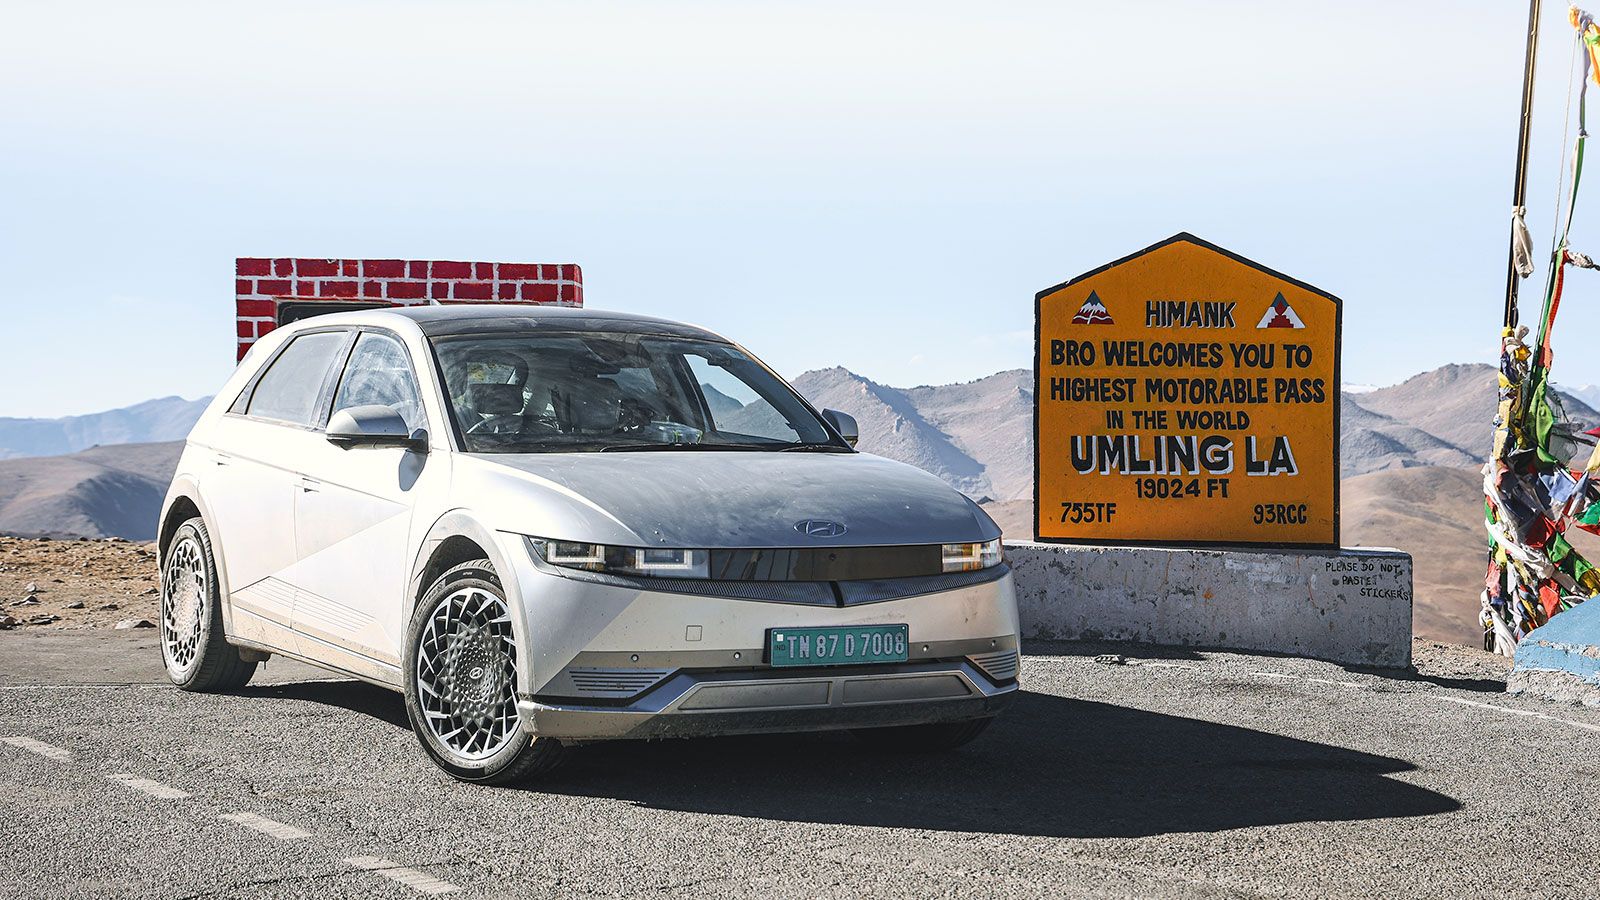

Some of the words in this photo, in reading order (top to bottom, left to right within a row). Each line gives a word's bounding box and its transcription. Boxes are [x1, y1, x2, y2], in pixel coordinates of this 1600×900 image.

[1145, 300, 1237, 328] HIMANK
[1050, 339, 1096, 367] BRO
[1103, 340, 1224, 368] WELCOMES
[1230, 343, 1274, 369] YOU
[1283, 344, 1313, 368] TO
[1050, 377, 1137, 403] HIGHEST
[1145, 378, 1268, 404] MOTORABLE
[1274, 378, 1325, 404] PASS
[1106, 410, 1124, 430] IN
[1131, 410, 1168, 430] THE
[1176, 410, 1250, 430] WORLD
[1070, 435, 1234, 476] UMLING
[1245, 435, 1299, 476] LA
[1135, 478, 1201, 499] 19024
[1207, 478, 1230, 499] FT
[1061, 502, 1117, 524] 755TF
[1253, 503, 1308, 525] 93RCC
[1325, 561, 1358, 572] PLEASE
[1361, 563, 1375, 572] DO
[1380, 563, 1401, 574] NOT
[1360, 587, 1409, 601] STICKERS
[787, 635, 810, 659] TN
[816, 634, 839, 658] 87
[845, 633, 856, 657] D
[861, 631, 905, 656] 7008
